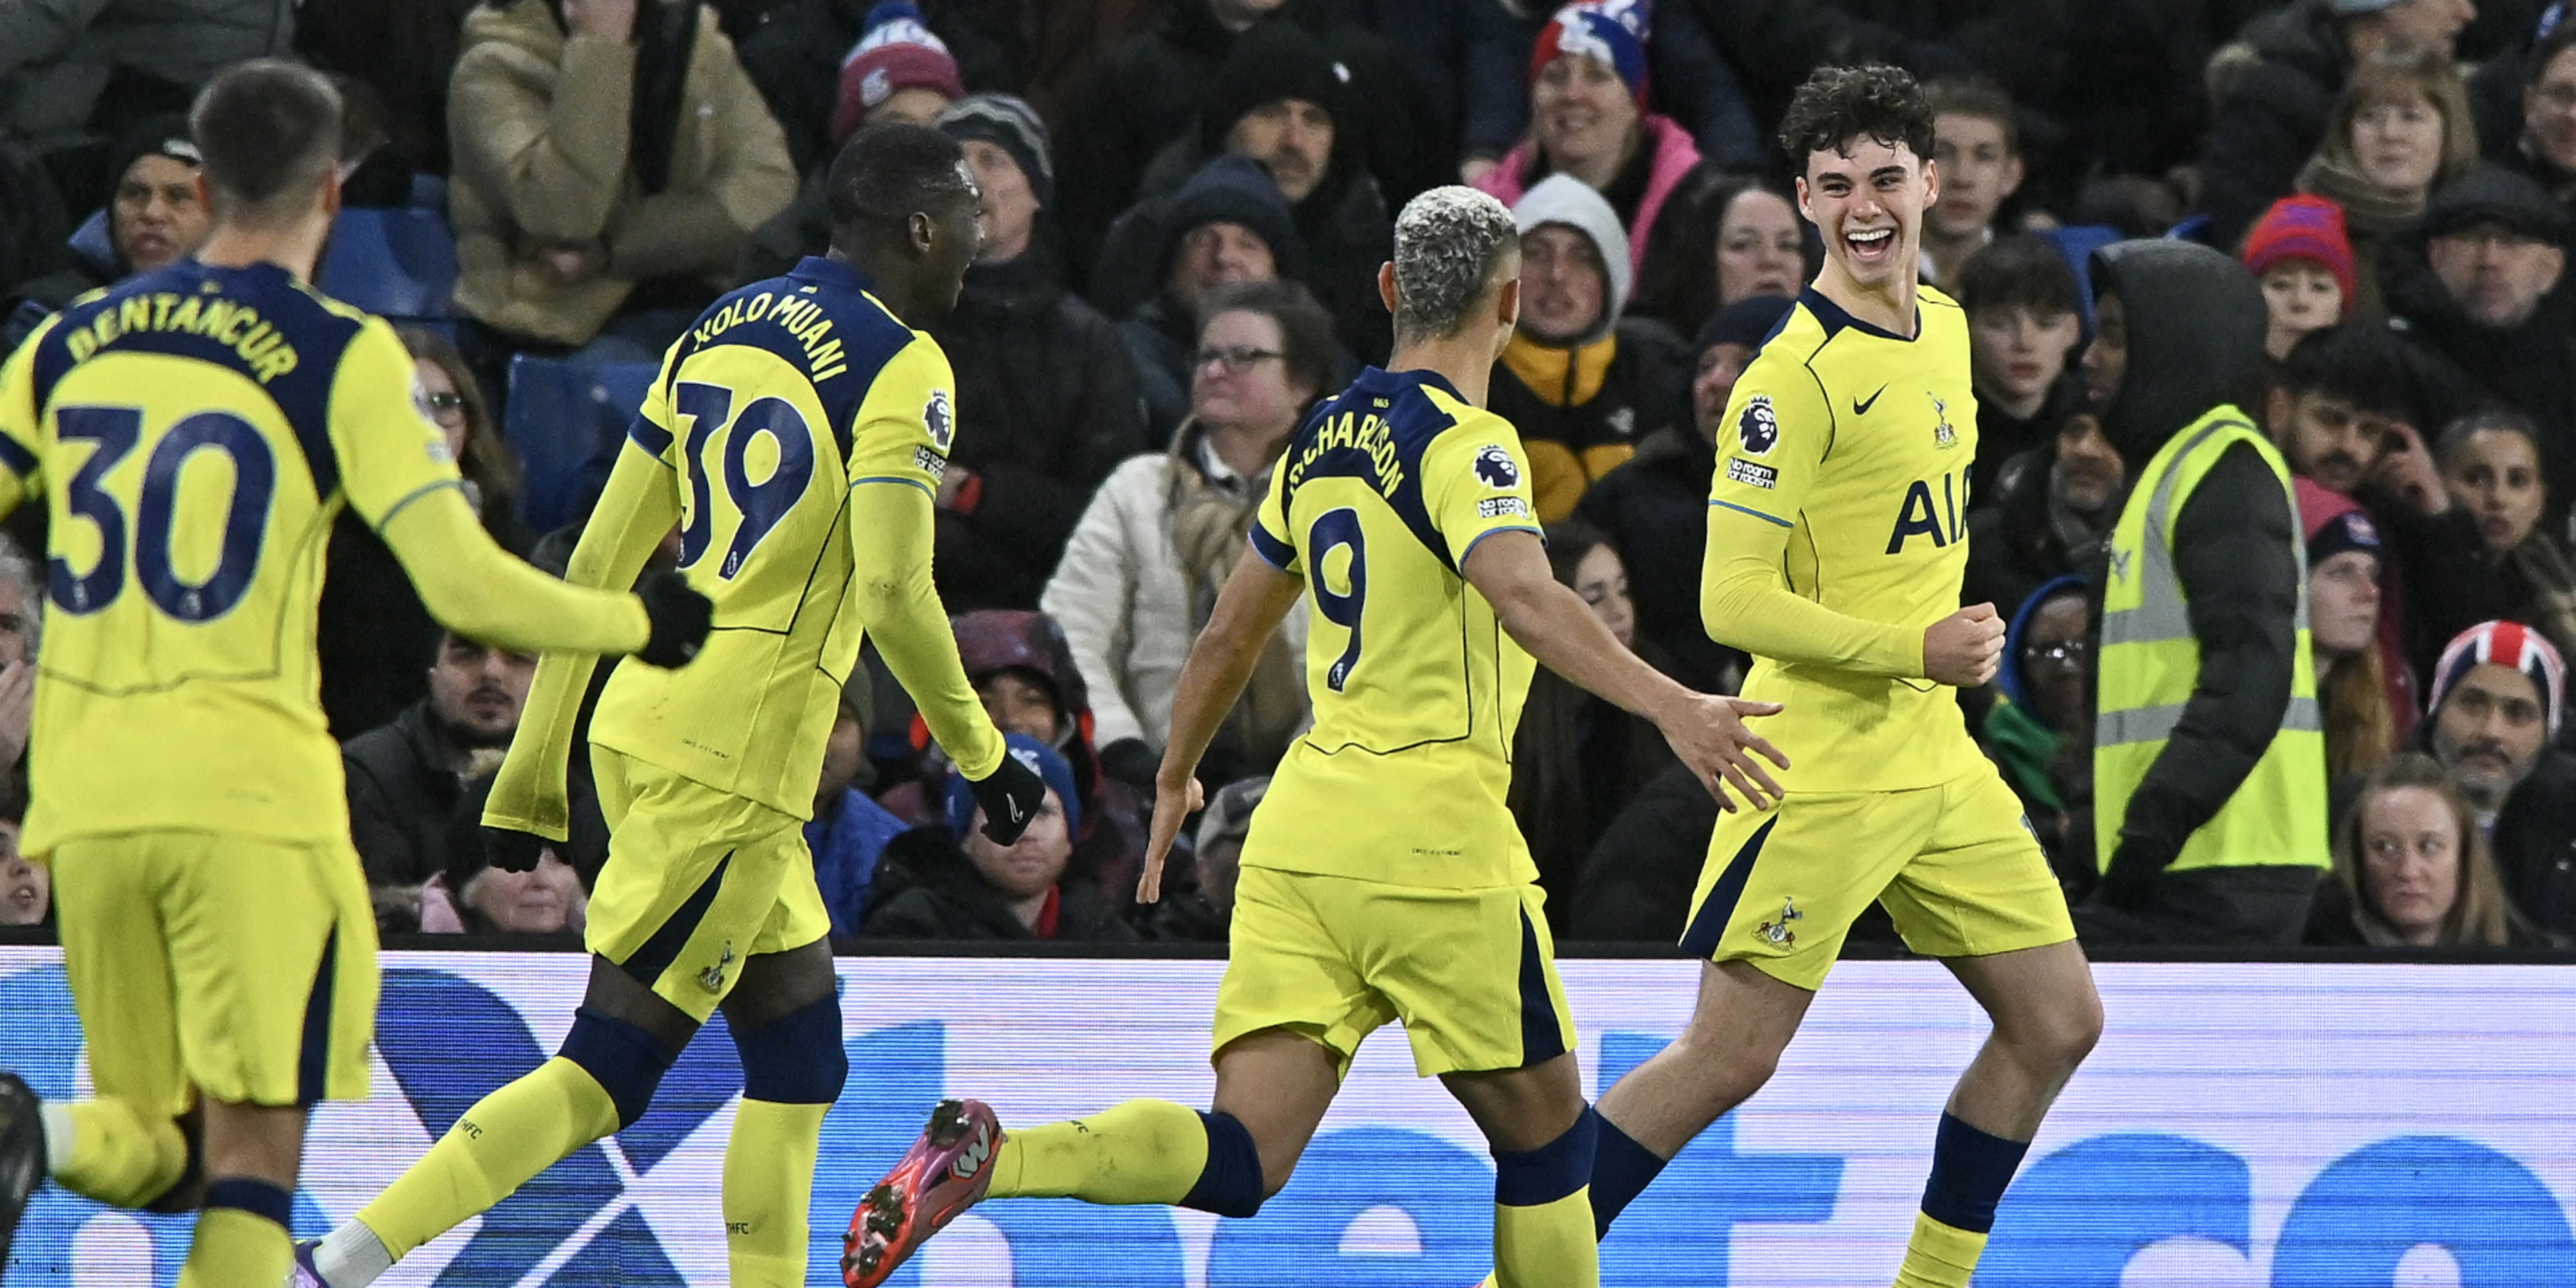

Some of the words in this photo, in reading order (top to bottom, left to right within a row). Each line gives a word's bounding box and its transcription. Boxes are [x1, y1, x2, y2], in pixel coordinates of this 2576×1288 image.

[66, 292, 299, 384] BENTANCUR
[693, 292, 773, 352] KOLO
[767, 295, 847, 382] MUANI
[676, 382, 816, 581] 39
[1477, 499, 1496, 509] No
[1729, 457, 1743, 470] No
[1743, 463, 1772, 479] room
[1739, 472, 1775, 490] racism
[47, 406, 276, 624] 30
[1309, 507, 1366, 693] 9
